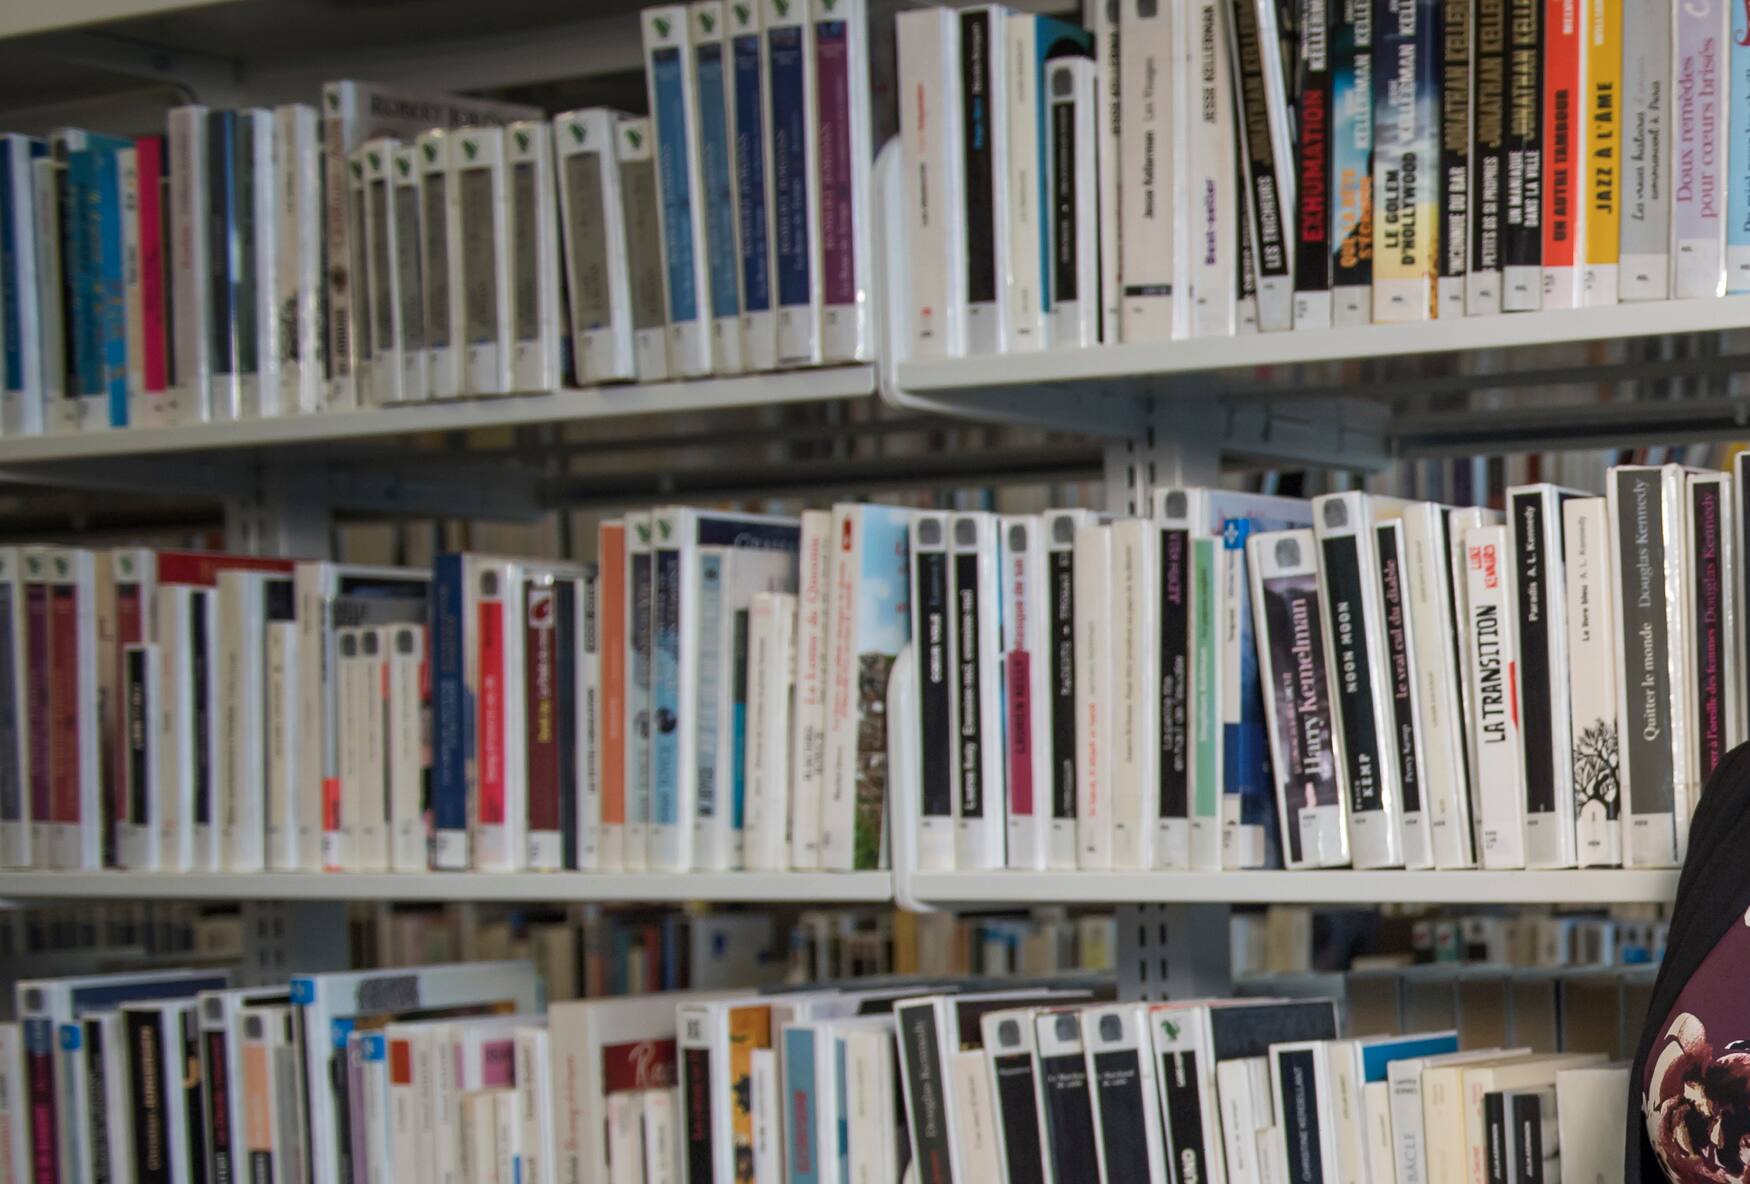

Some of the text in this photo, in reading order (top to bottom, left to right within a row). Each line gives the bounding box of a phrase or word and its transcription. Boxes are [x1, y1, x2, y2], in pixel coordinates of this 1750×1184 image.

[1202, 5, 1216, 123] JESSE KELLERMAN
[1398, 44, 1416, 141] KELLERMAN
[1512, 49, 1536, 140] JONATHAN
[1478, 56, 1503, 147] JONATHAN
[1676, 56, 1694, 203] Doux remèdes
[1698, 37, 1718, 219] pour cœurs brisés
[1301, 89, 1325, 242] EXHUMATION
[1553, 89, 1569, 242] UN AUTRE TAMBOUR
[1593, 80, 1613, 215] JAZZ À L'ÂME
[1258, 175, 1282, 269] LES TRICHEURS
[1384, 170, 1400, 249] LE GOLEM
[1401, 152, 1417, 265] D'HOLLYWOOD
[1508, 150, 1523, 224] UN MANIAQUE
[1524, 150, 1539, 227] DANS LA VILLE
[1632, 203, 1645, 221] Les
[1449, 214, 1466, 275] 'INCONNUE
[1469, 545, 1482, 571] LUKE
[1577, 515, 1588, 556] Kennedy
[1701, 491, 1716, 559] Kennedy
[1384, 558, 1400, 604] diable
[1524, 505, 1539, 622] Paradis A. L. Kennedy
[1579, 585, 1589, 605] bleu
[1703, 562, 1718, 624] Douglas
[1388, 607, 1402, 624] du
[1392, 629, 1404, 650] cul
[1580, 607, 1590, 627] livre
[1580, 629, 1591, 642] Le
[1634, 478, 1660, 742] Quitter le monde Douglas Kennedy
[1291, 598, 1318, 713] Kemelman
[1338, 601, 1359, 693] NOON MOON
[1393, 654, 1408, 680] vrai
[1476, 604, 1506, 744] LA TRANSITION
[1705, 628, 1717, 673] femmes
[1395, 684, 1409, 698] Le
[1705, 675, 1717, 694] des
[1706, 696, 1719, 739] l'oreille
[1301, 714, 1325, 775] Harry
[1358, 753, 1374, 797] KEMP
